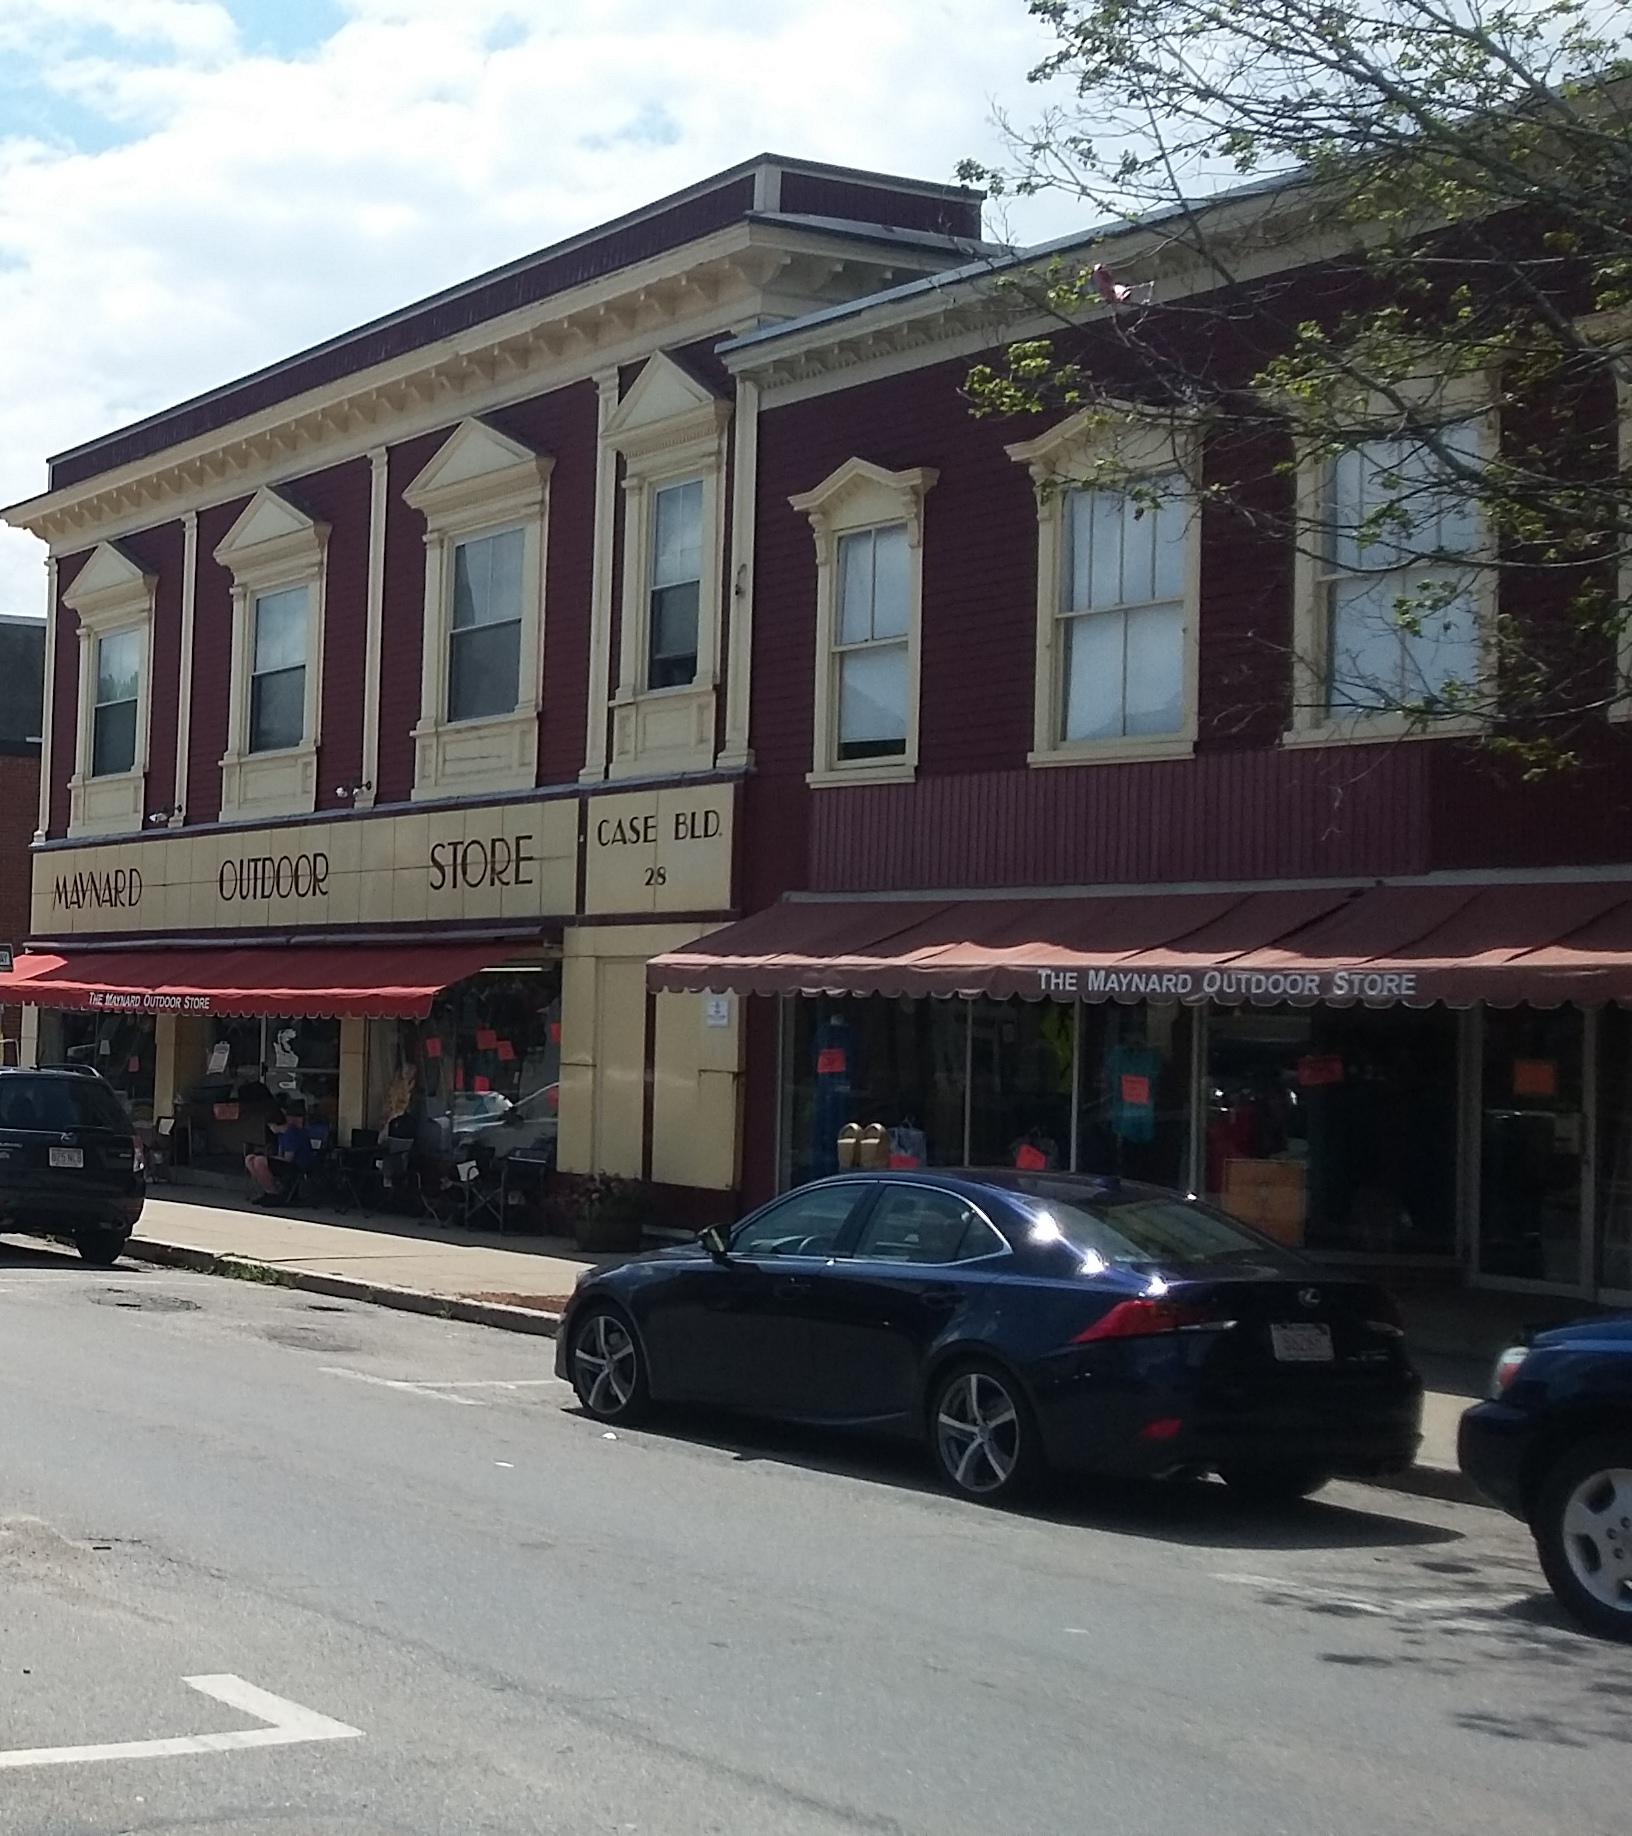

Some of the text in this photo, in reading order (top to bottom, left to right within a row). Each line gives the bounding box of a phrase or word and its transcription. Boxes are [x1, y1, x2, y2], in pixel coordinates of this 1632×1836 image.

[597, 814, 658, 848] CASE
[52, 834, 534, 911] MAYNARD OUTDOOR STORE
[644, 866, 667, 887] 28
[1037, 968, 1417, 996] THE MAYNARD OUTDOOR STORE
[89, 991, 210, 1010] THE MAYNARD OUTDOOR STORE
